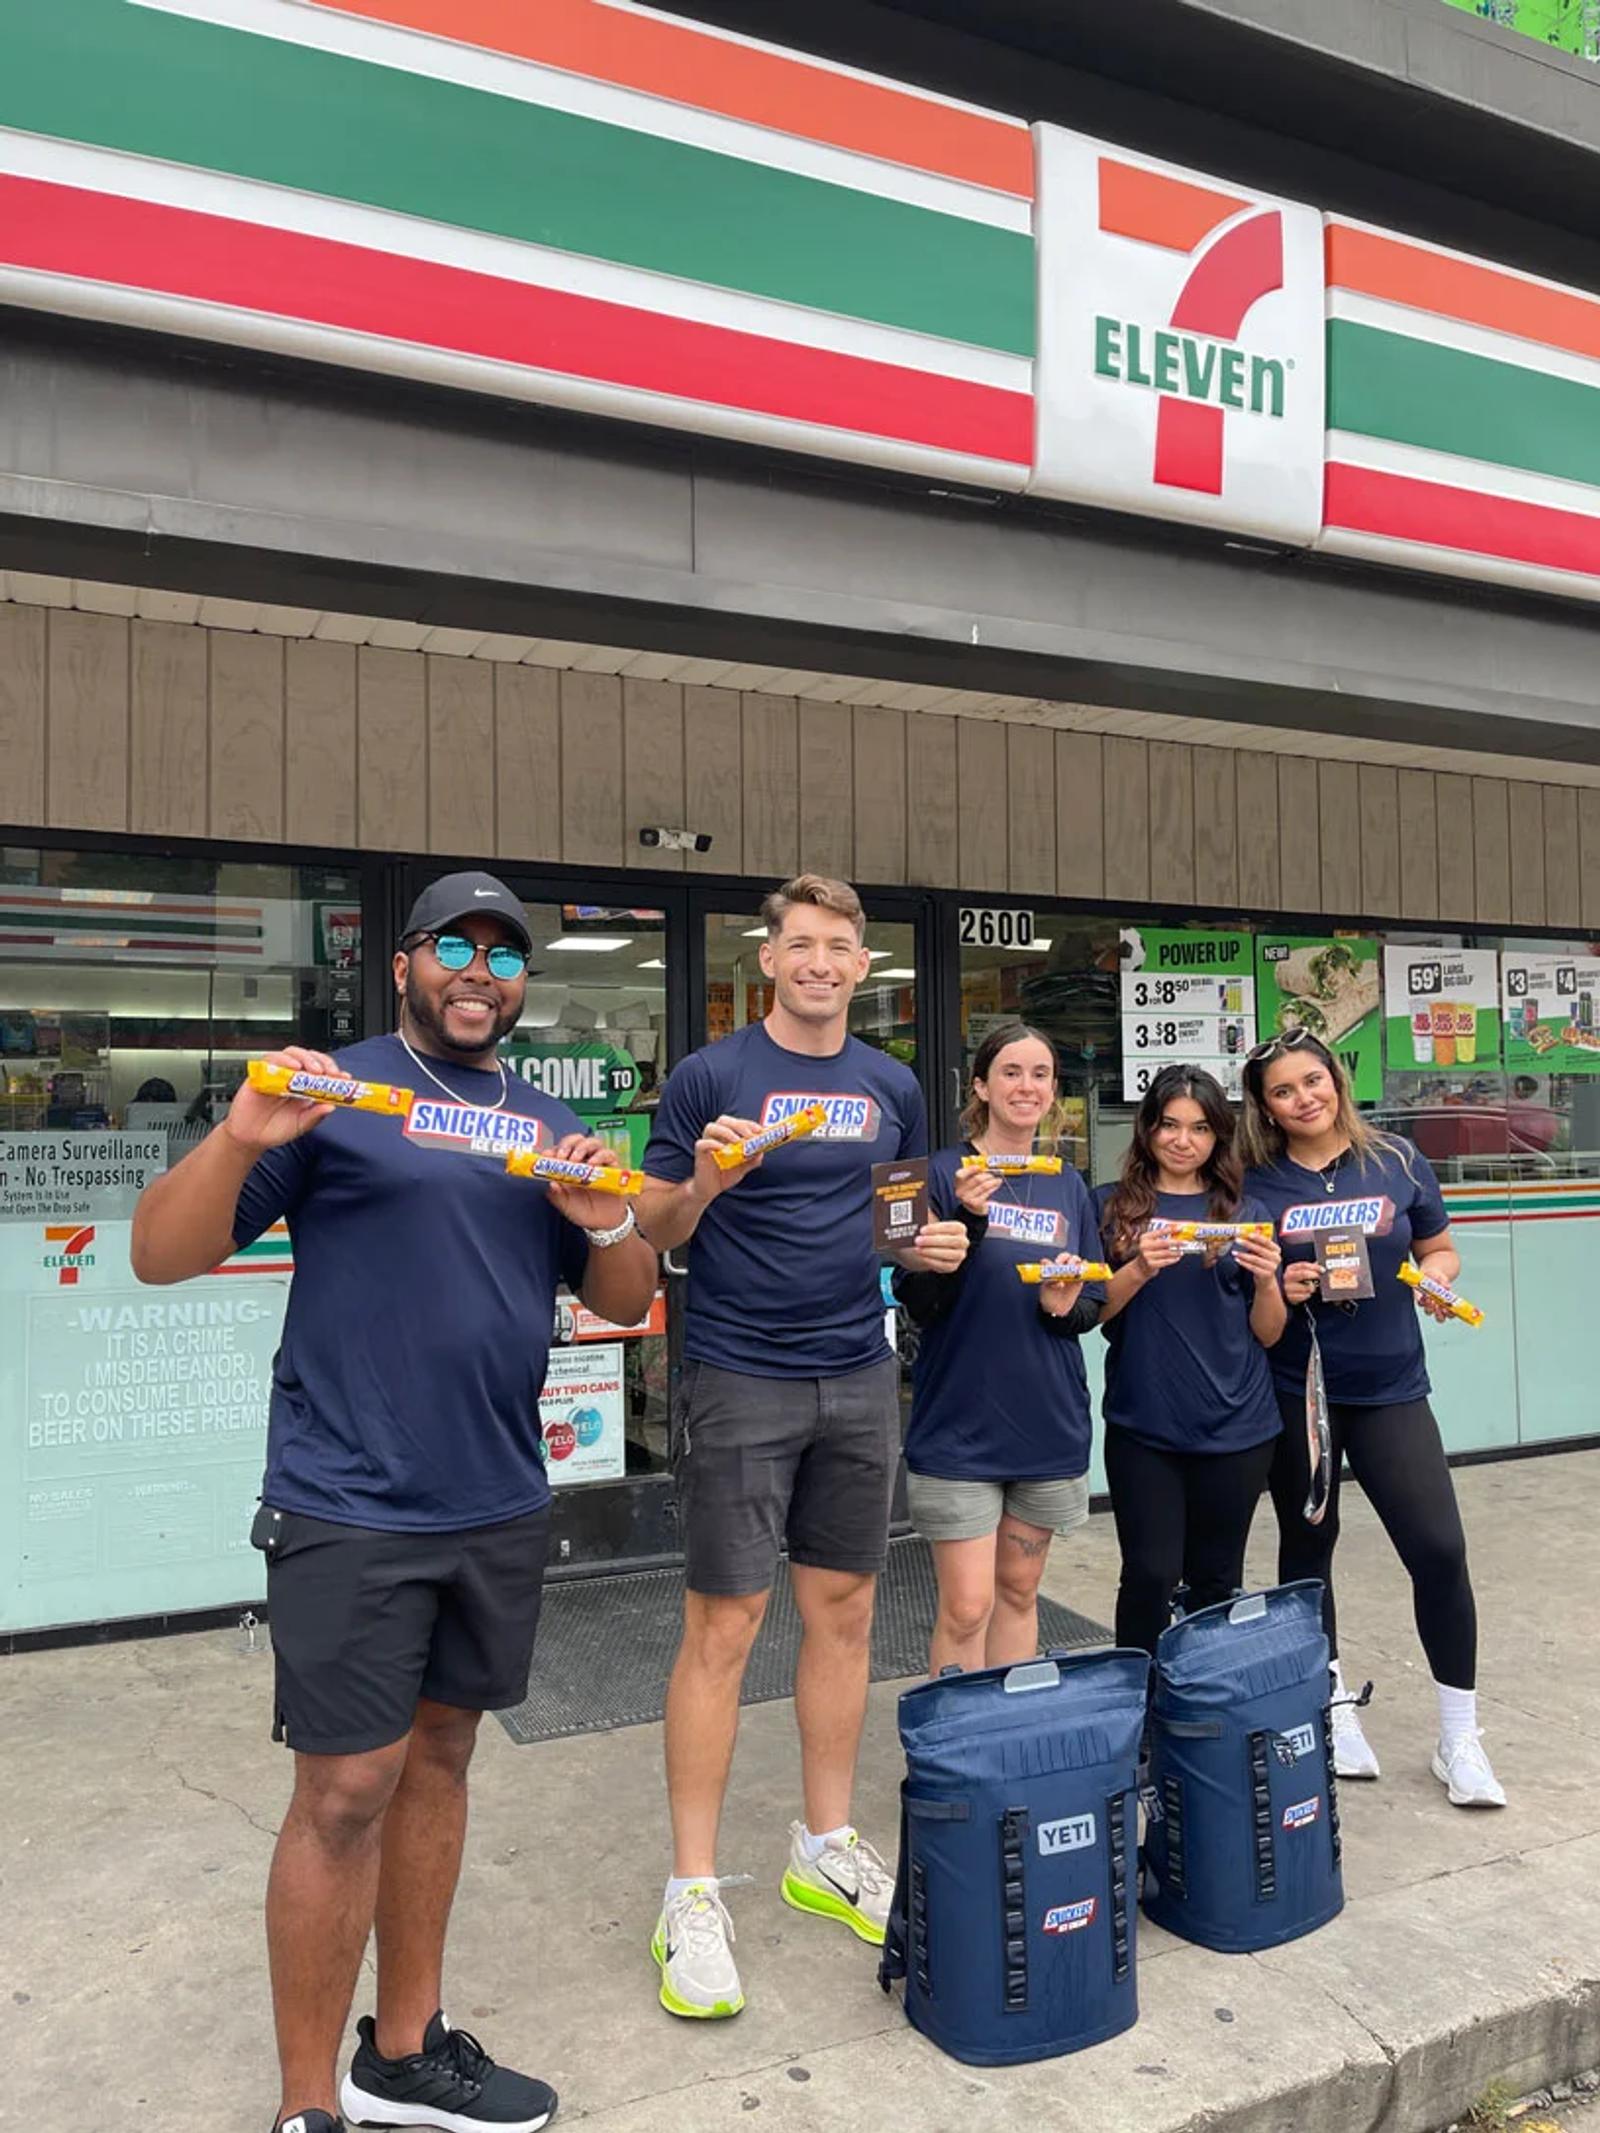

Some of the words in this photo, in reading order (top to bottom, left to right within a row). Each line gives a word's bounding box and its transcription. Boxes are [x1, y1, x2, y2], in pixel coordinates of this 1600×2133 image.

[1097, 155, 1284, 496] 7
[960, 909, 1032, 946] 2600
[1158, 940, 1217, 967] POWER
[1218, 939, 1241, 962] UP
[1134, 982, 1148, 1007] 3
[1135, 1023, 1149, 1049] 3
[291, 1074, 352, 1094] SNICKERS
[611, 1069, 633, 1090] TO
[1136, 1068, 1150, 1093] 3
[414, 1104, 536, 1147] SNICKERS
[811, 1126, 828, 1138] ICE
[828, 1126, 863, 1139] CREAM
[62, 1138, 160, 1162] Surveillance
[470, 1138, 491, 1152] ICE
[26, 1165, 47, 1187] No
[51, 1164, 145, 1191] Trespassing
[4, 1190, 33, 1202] System
[16, 1202, 37, 1216] Open
[38, 1202, 51, 1213] The
[53, 1202, 72, 1215] Drop
[73, 1201, 91, 1213] Safe
[988, 1204, 1056, 1233] NICKERS
[1286, 1200, 1381, 1231] SNICKERS
[45, 1225, 96, 1286] 7
[106, 1333, 125, 1359] IT
[130, 1332, 149, 1358] IS
[153, 1331, 168, 1356] A
[172, 1327, 235, 1354] CRIME
[40, 1391, 70, 1419] TO
[76, 1383, 180, 1416] CONSUME
[185, 1379, 261, 1407] LIQUOR
[563, 1384, 588, 1396] TWO
[588, 1380, 621, 1394] CANS
[29, 1417, 87, 1448] BEER
[93, 1413, 124, 1442] ON
[127, 1408, 197, 1440] THESE
[547, 1434, 575, 1447] VELO
[1290, 1729, 1313, 1754] ETI
[1043, 1822, 1091, 1848] YETI
